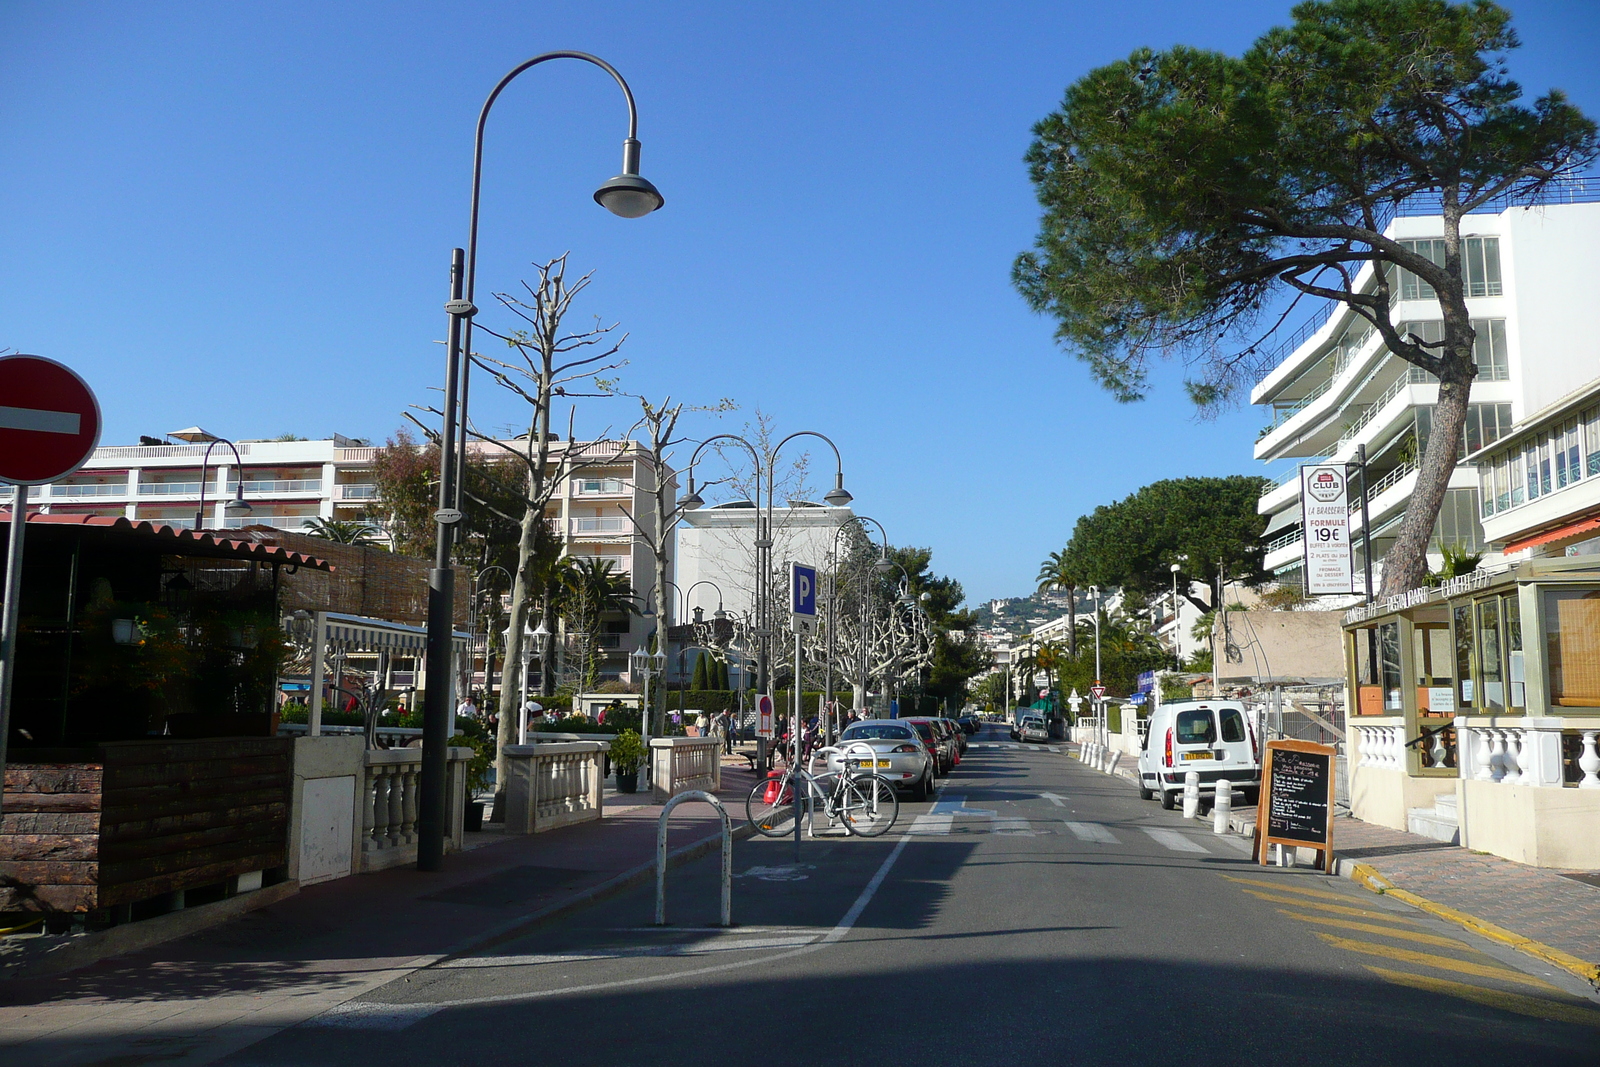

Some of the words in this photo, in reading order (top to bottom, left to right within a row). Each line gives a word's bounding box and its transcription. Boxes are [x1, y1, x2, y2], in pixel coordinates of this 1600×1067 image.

[1308, 507, 1315, 515] LA
[1316, 506, 1346, 515] BRASSERIE
[1310, 519, 1346, 527] FORMULE
[1314, 528, 1340, 542] 19€
[799, 575, 811, 606] P
